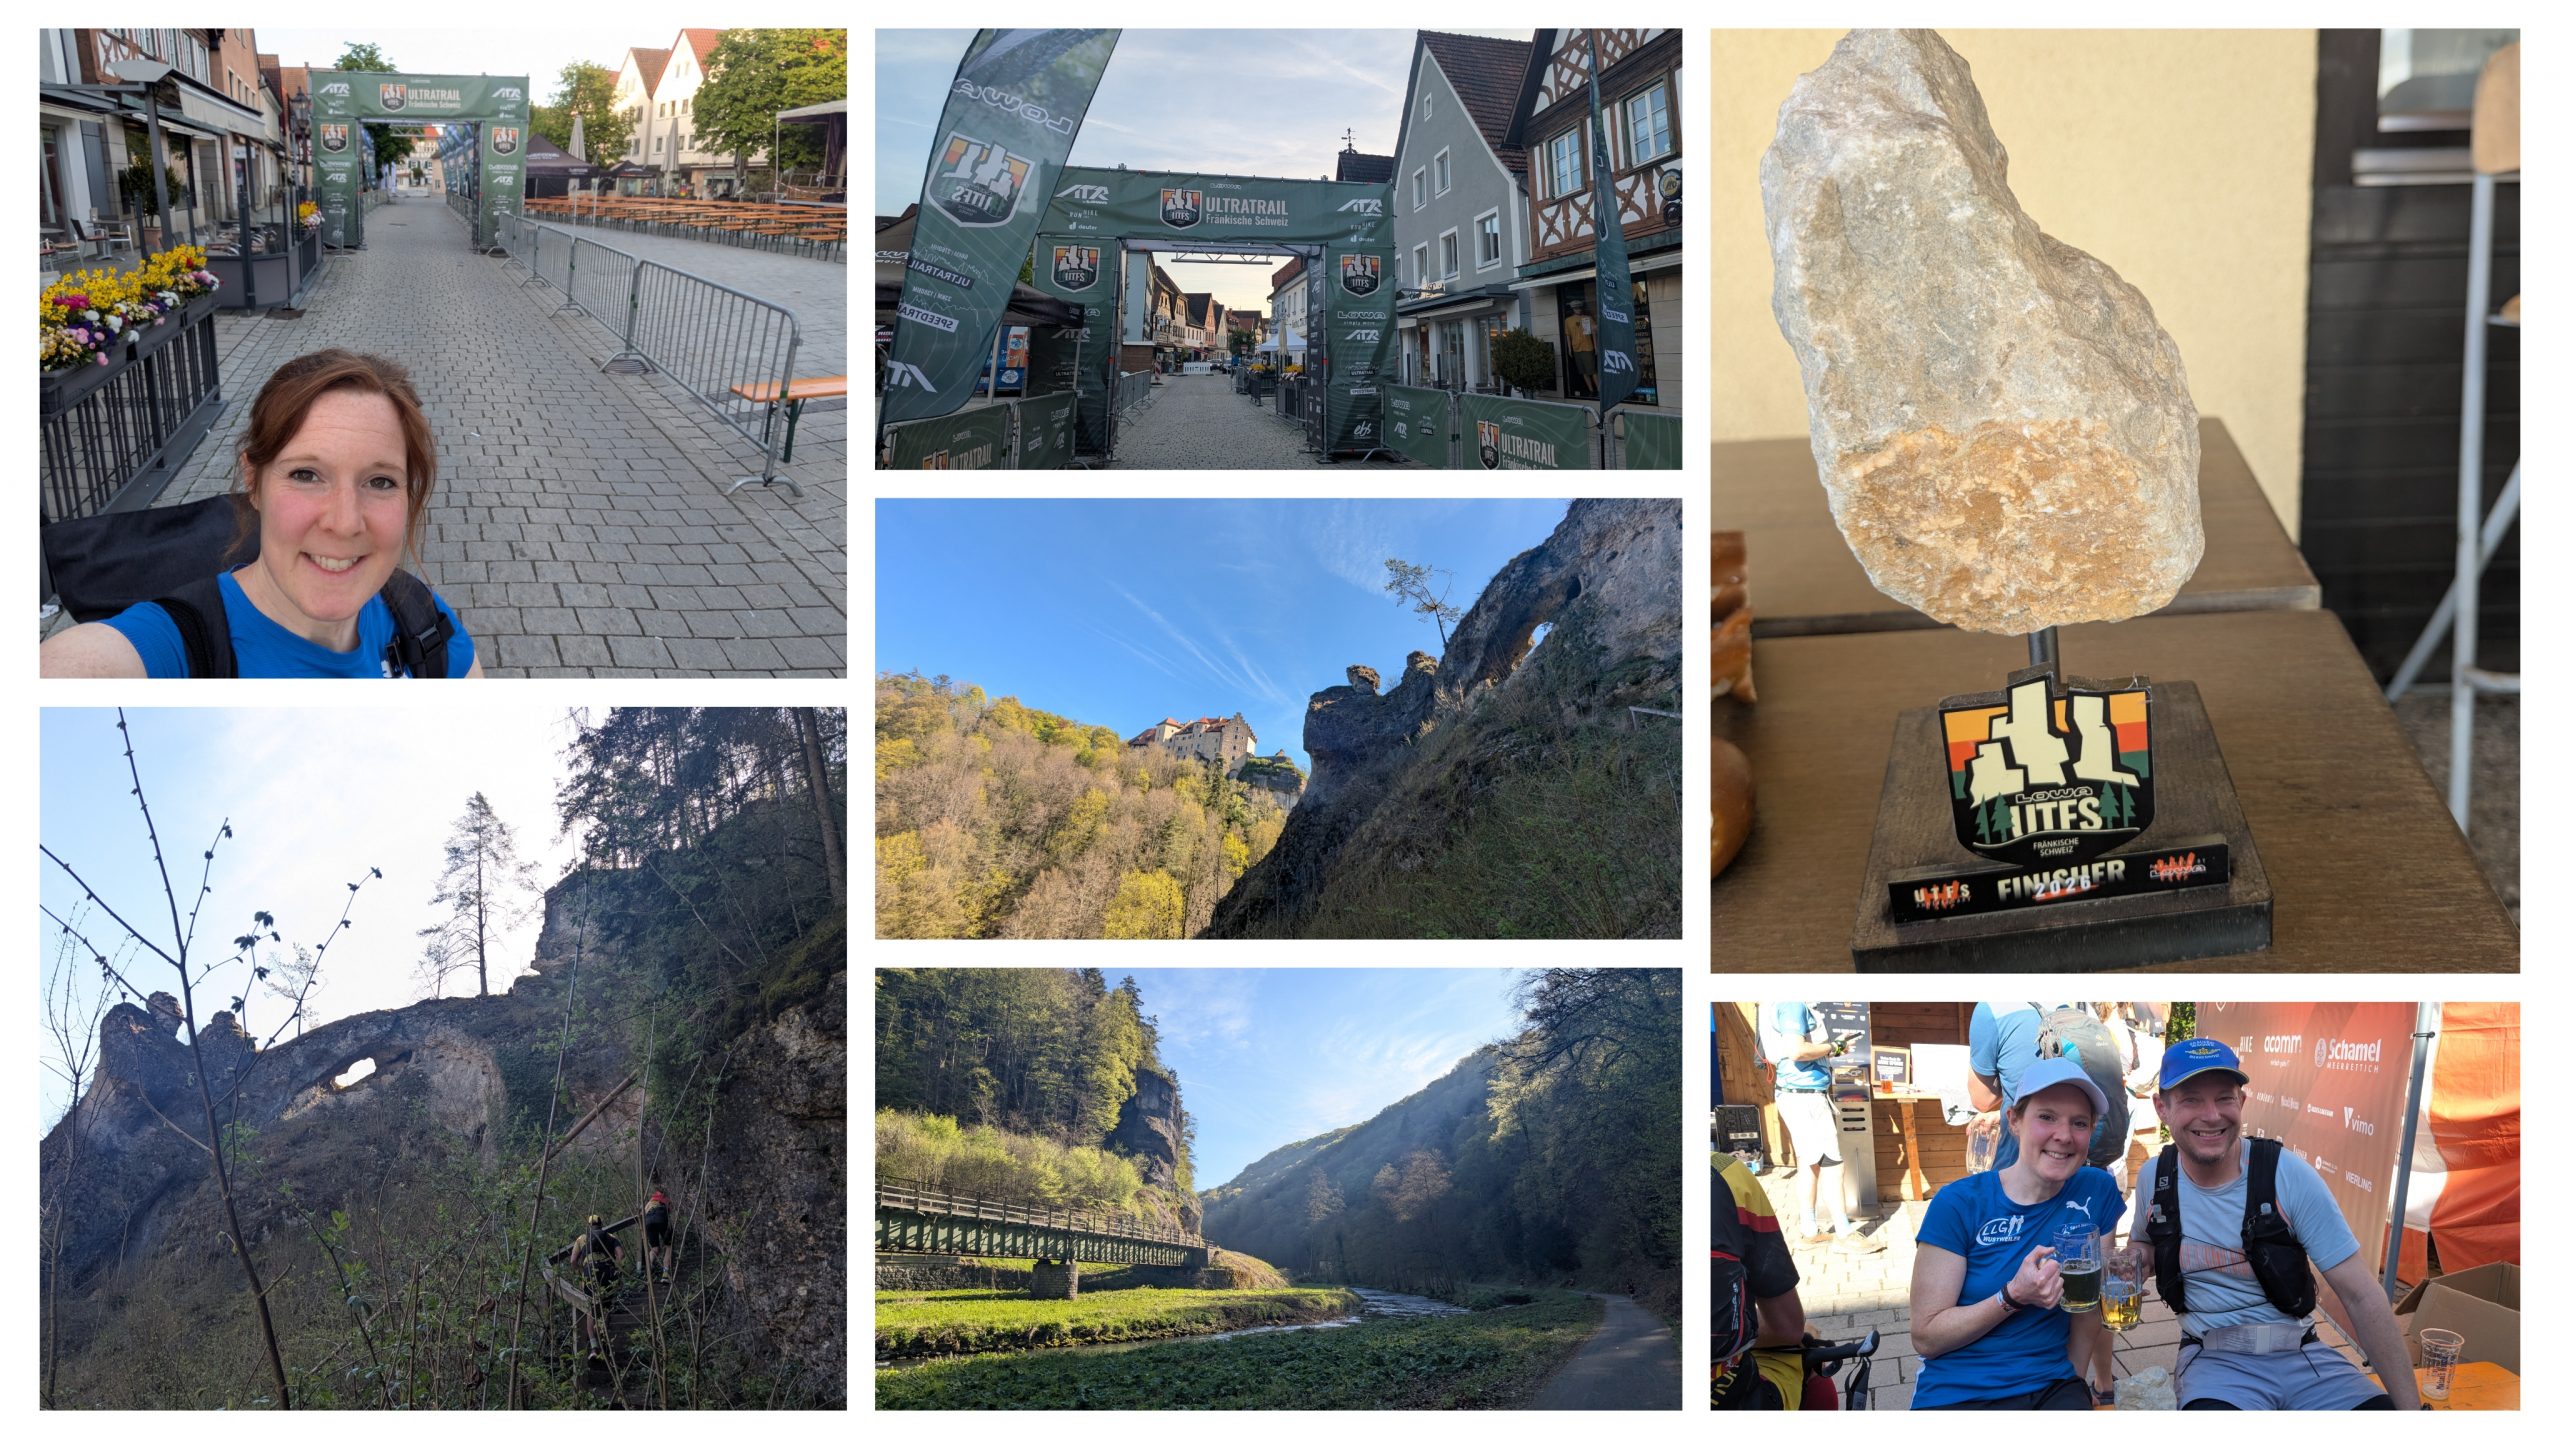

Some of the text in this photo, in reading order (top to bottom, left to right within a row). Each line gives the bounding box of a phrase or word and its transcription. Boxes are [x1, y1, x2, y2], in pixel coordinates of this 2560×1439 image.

[408, 89, 461, 101] ULTRATRAIL
[1205, 196, 1289, 216] ULTRATRAIL
[1206, 213, 1289, 227] Fränkische Schweiz
[1064, 272, 1086, 282] UTFS
[1337, 310, 1387, 320] LOWA
[950, 443, 993, 470] ULTRATRAIL
[1501, 432, 1560, 469] ULTRATRAIL
[2015, 785, 2094, 804] LOWA
[2009, 796, 2104, 841] UTFS
[2032, 837, 2080, 851] FRÄNKISCHE
[2039, 847, 2075, 857] SCHWEIZ
[1997, 859, 2127, 900] FINISHER
[2033, 875, 2093, 899] 2026
[2328, 1038, 2382, 1062] Schamel
[2326, 1062, 2379, 1073] MEERRETTICH
[2351, 1115, 2375, 1136] vimo
[2345, 1170, 2373, 1193] VIERLING
[1982, 1220, 2008, 1236] LLG
